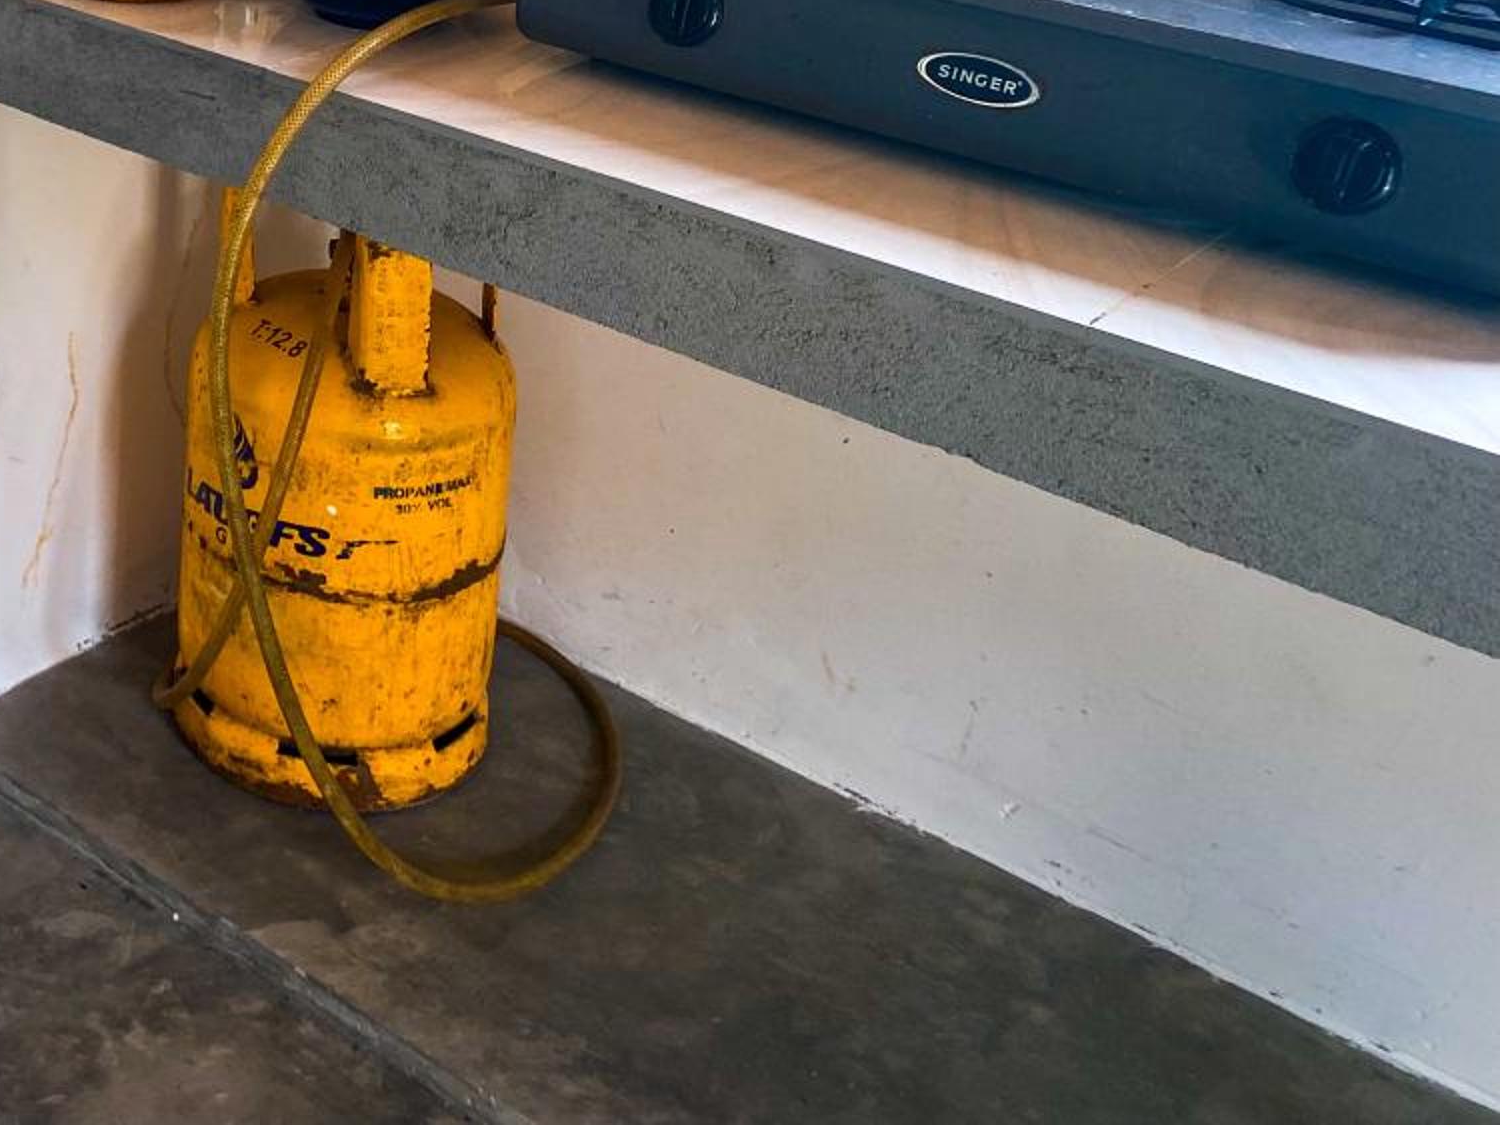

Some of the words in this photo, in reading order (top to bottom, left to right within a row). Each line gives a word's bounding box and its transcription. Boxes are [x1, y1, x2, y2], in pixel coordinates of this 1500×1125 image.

[937, 64, 1019, 96] SINGER
[249, 319, 308, 358] T:12.8
[373, 481, 443, 500] PROPANE
